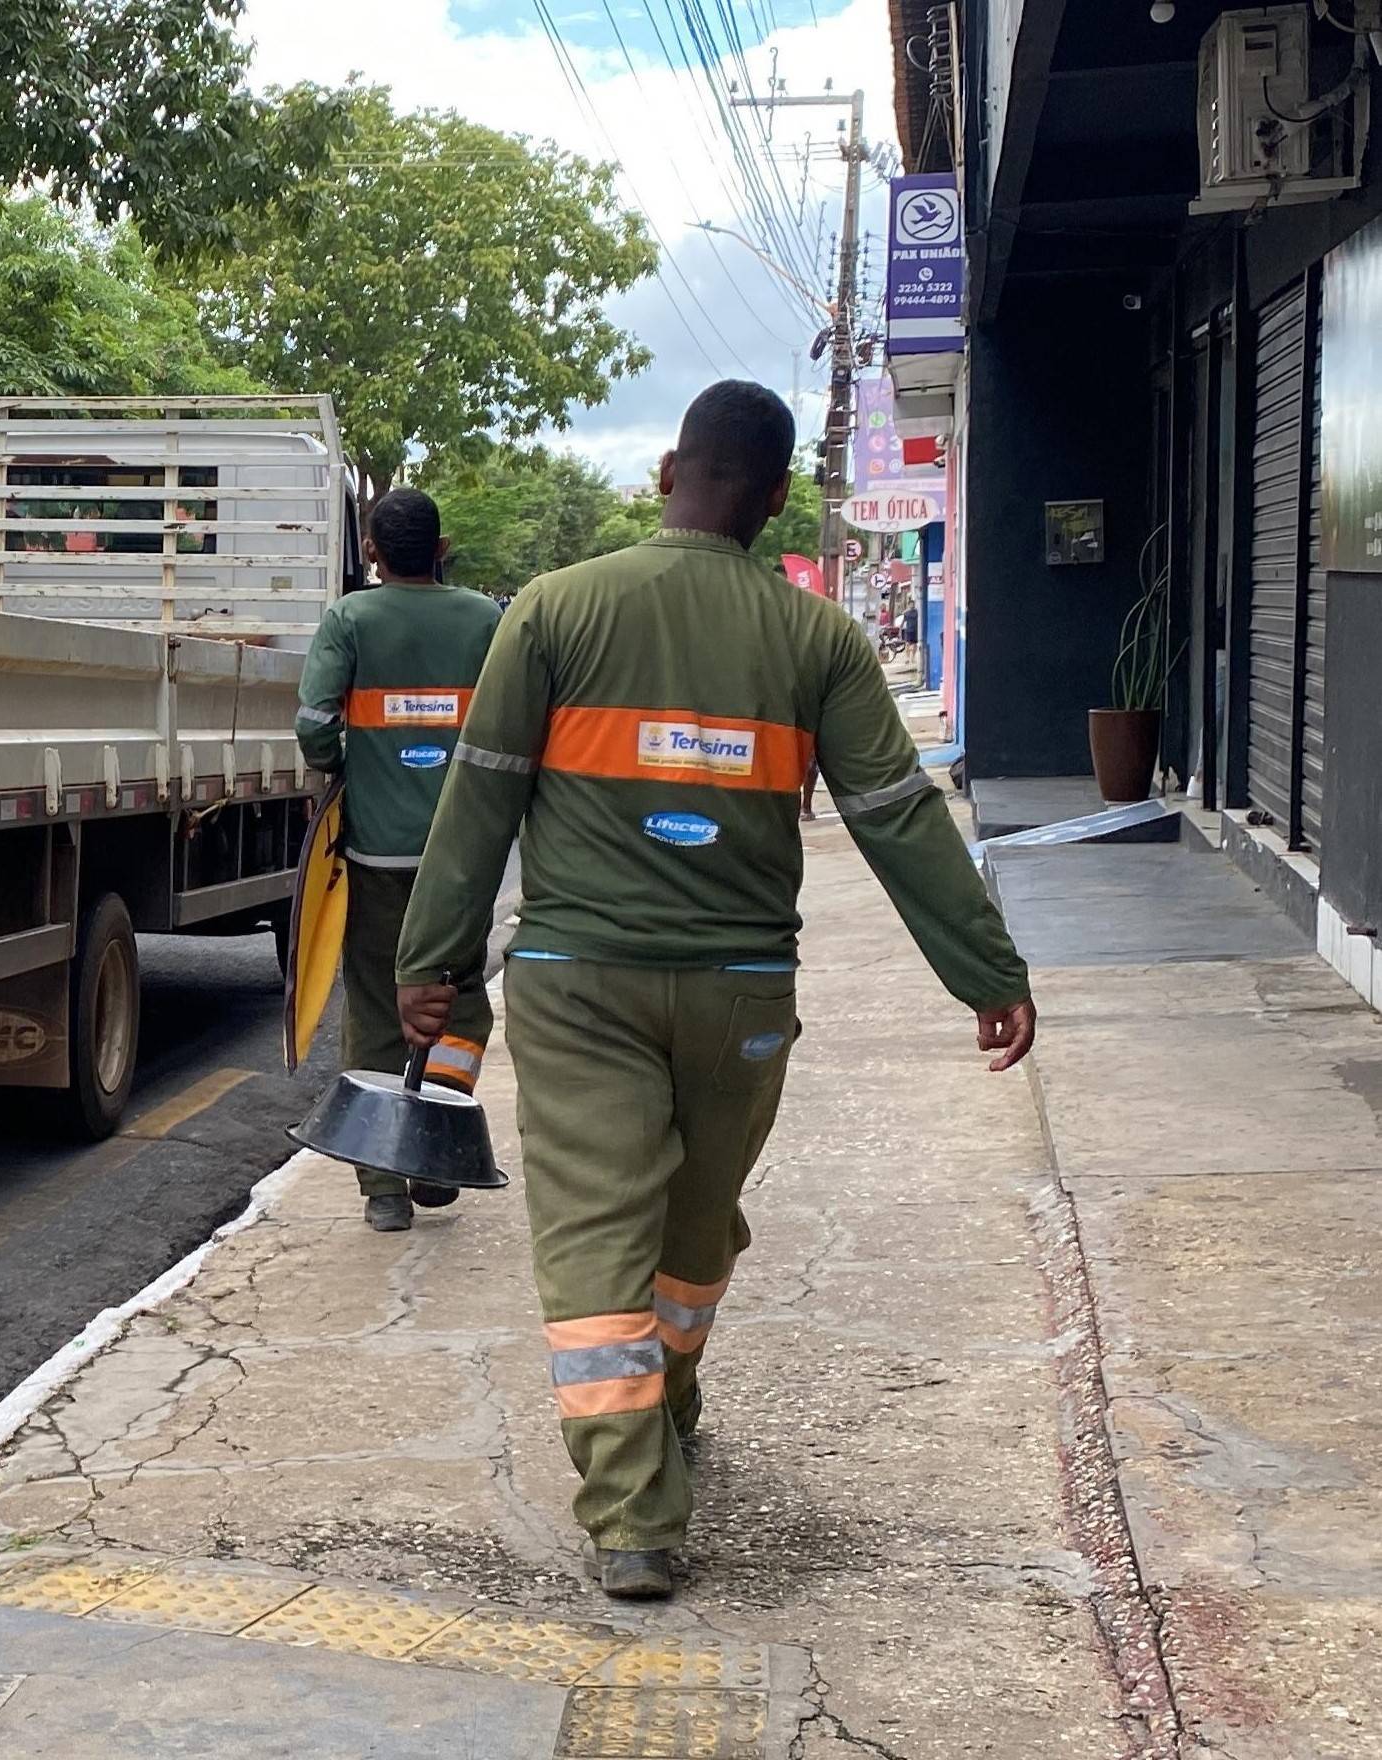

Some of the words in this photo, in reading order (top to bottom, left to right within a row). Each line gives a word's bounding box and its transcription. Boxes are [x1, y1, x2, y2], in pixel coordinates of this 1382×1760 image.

[893, 249, 917, 260] PAX
[920, 247, 960, 259] UNIÃO
[898, 283, 924, 293] 3236
[926, 282, 953, 292] 5322
[851, 500, 879, 522] TEM
[887, 495, 928, 520] ÓTICA
[403, 700, 455, 712] Teresina
[670, 731, 748, 757] Teresina
